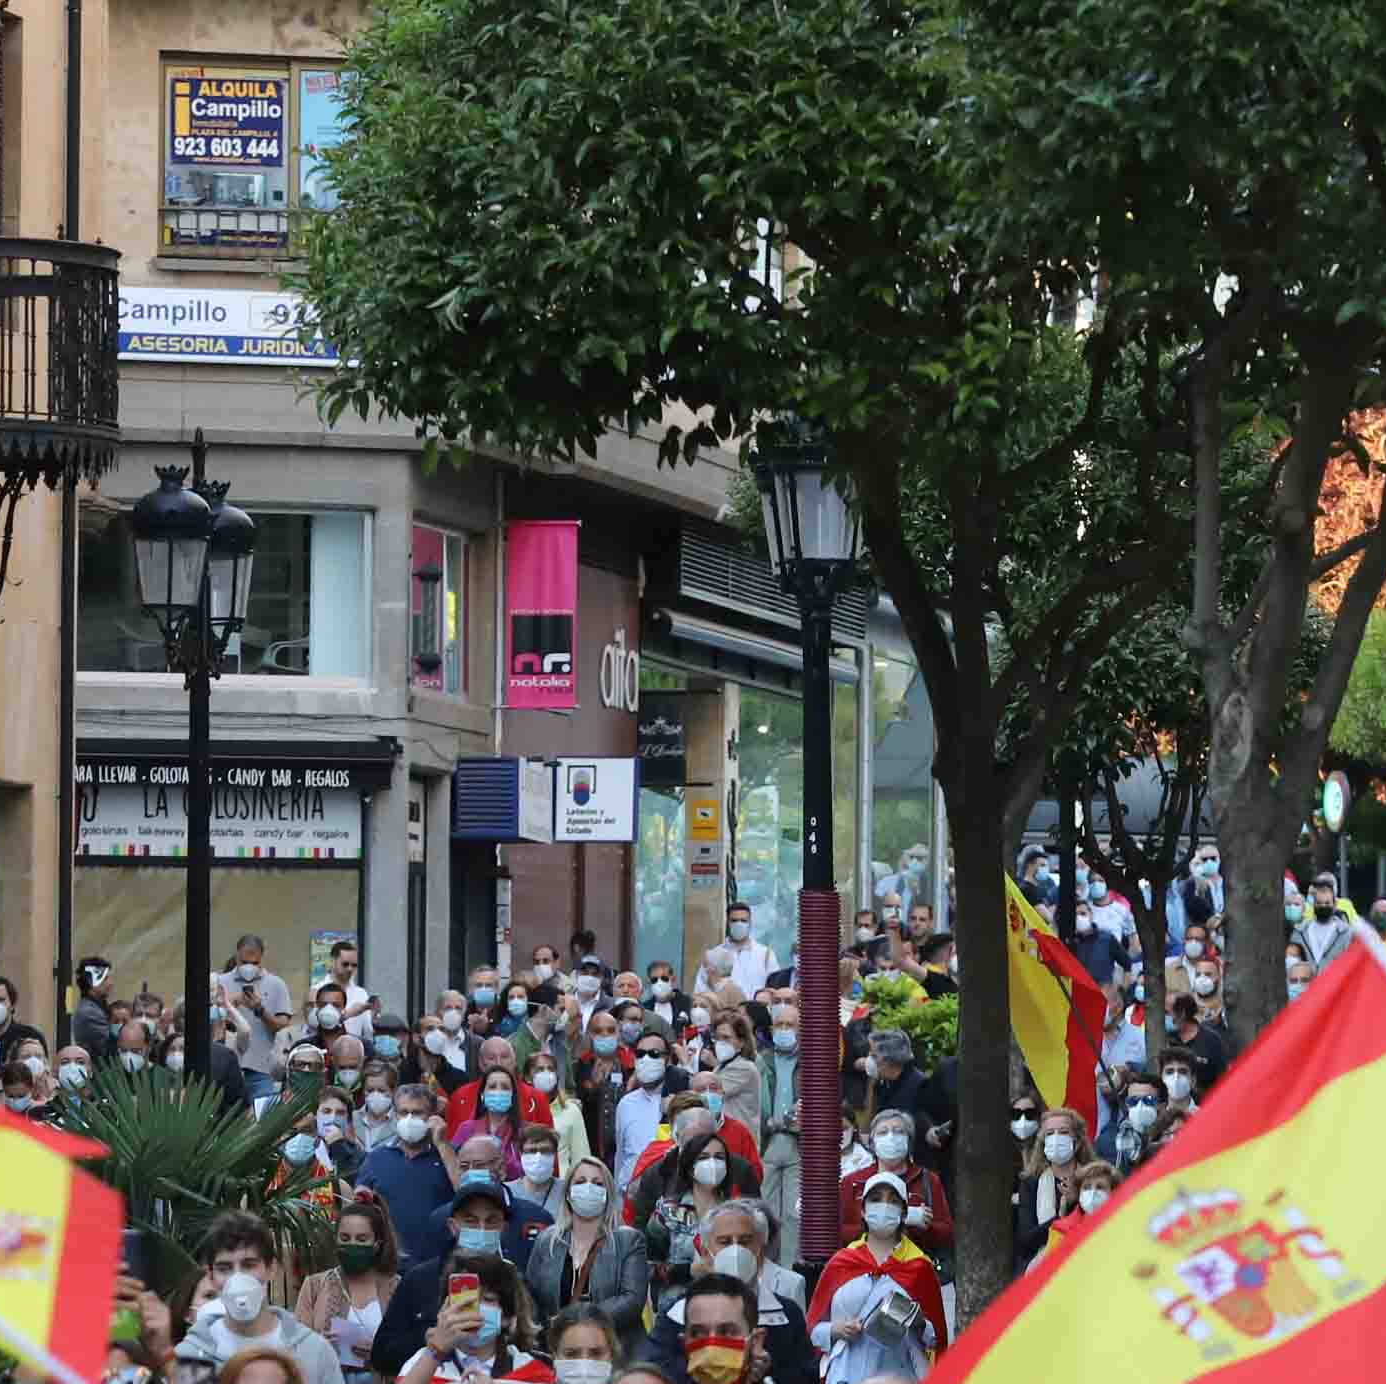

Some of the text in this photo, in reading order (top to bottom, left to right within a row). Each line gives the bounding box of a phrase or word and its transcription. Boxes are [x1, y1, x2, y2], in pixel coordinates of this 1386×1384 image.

[198, 82, 278, 97] ALQUILA
[191, 98, 282, 121] Campillo
[174, 137, 279, 158] 923 603 444
[118, 297, 227, 325] Campillo
[127, 335, 228, 353] ASESORIA
[74, 765, 93, 783] ARA
[98, 765, 137, 783] LLEVAR
[227, 768, 265, 787] CANDY
[271, 769, 292, 786] BAR
[305, 770, 350, 788] REGALOS
[142, 786, 325, 822] LA LOSINERIA
